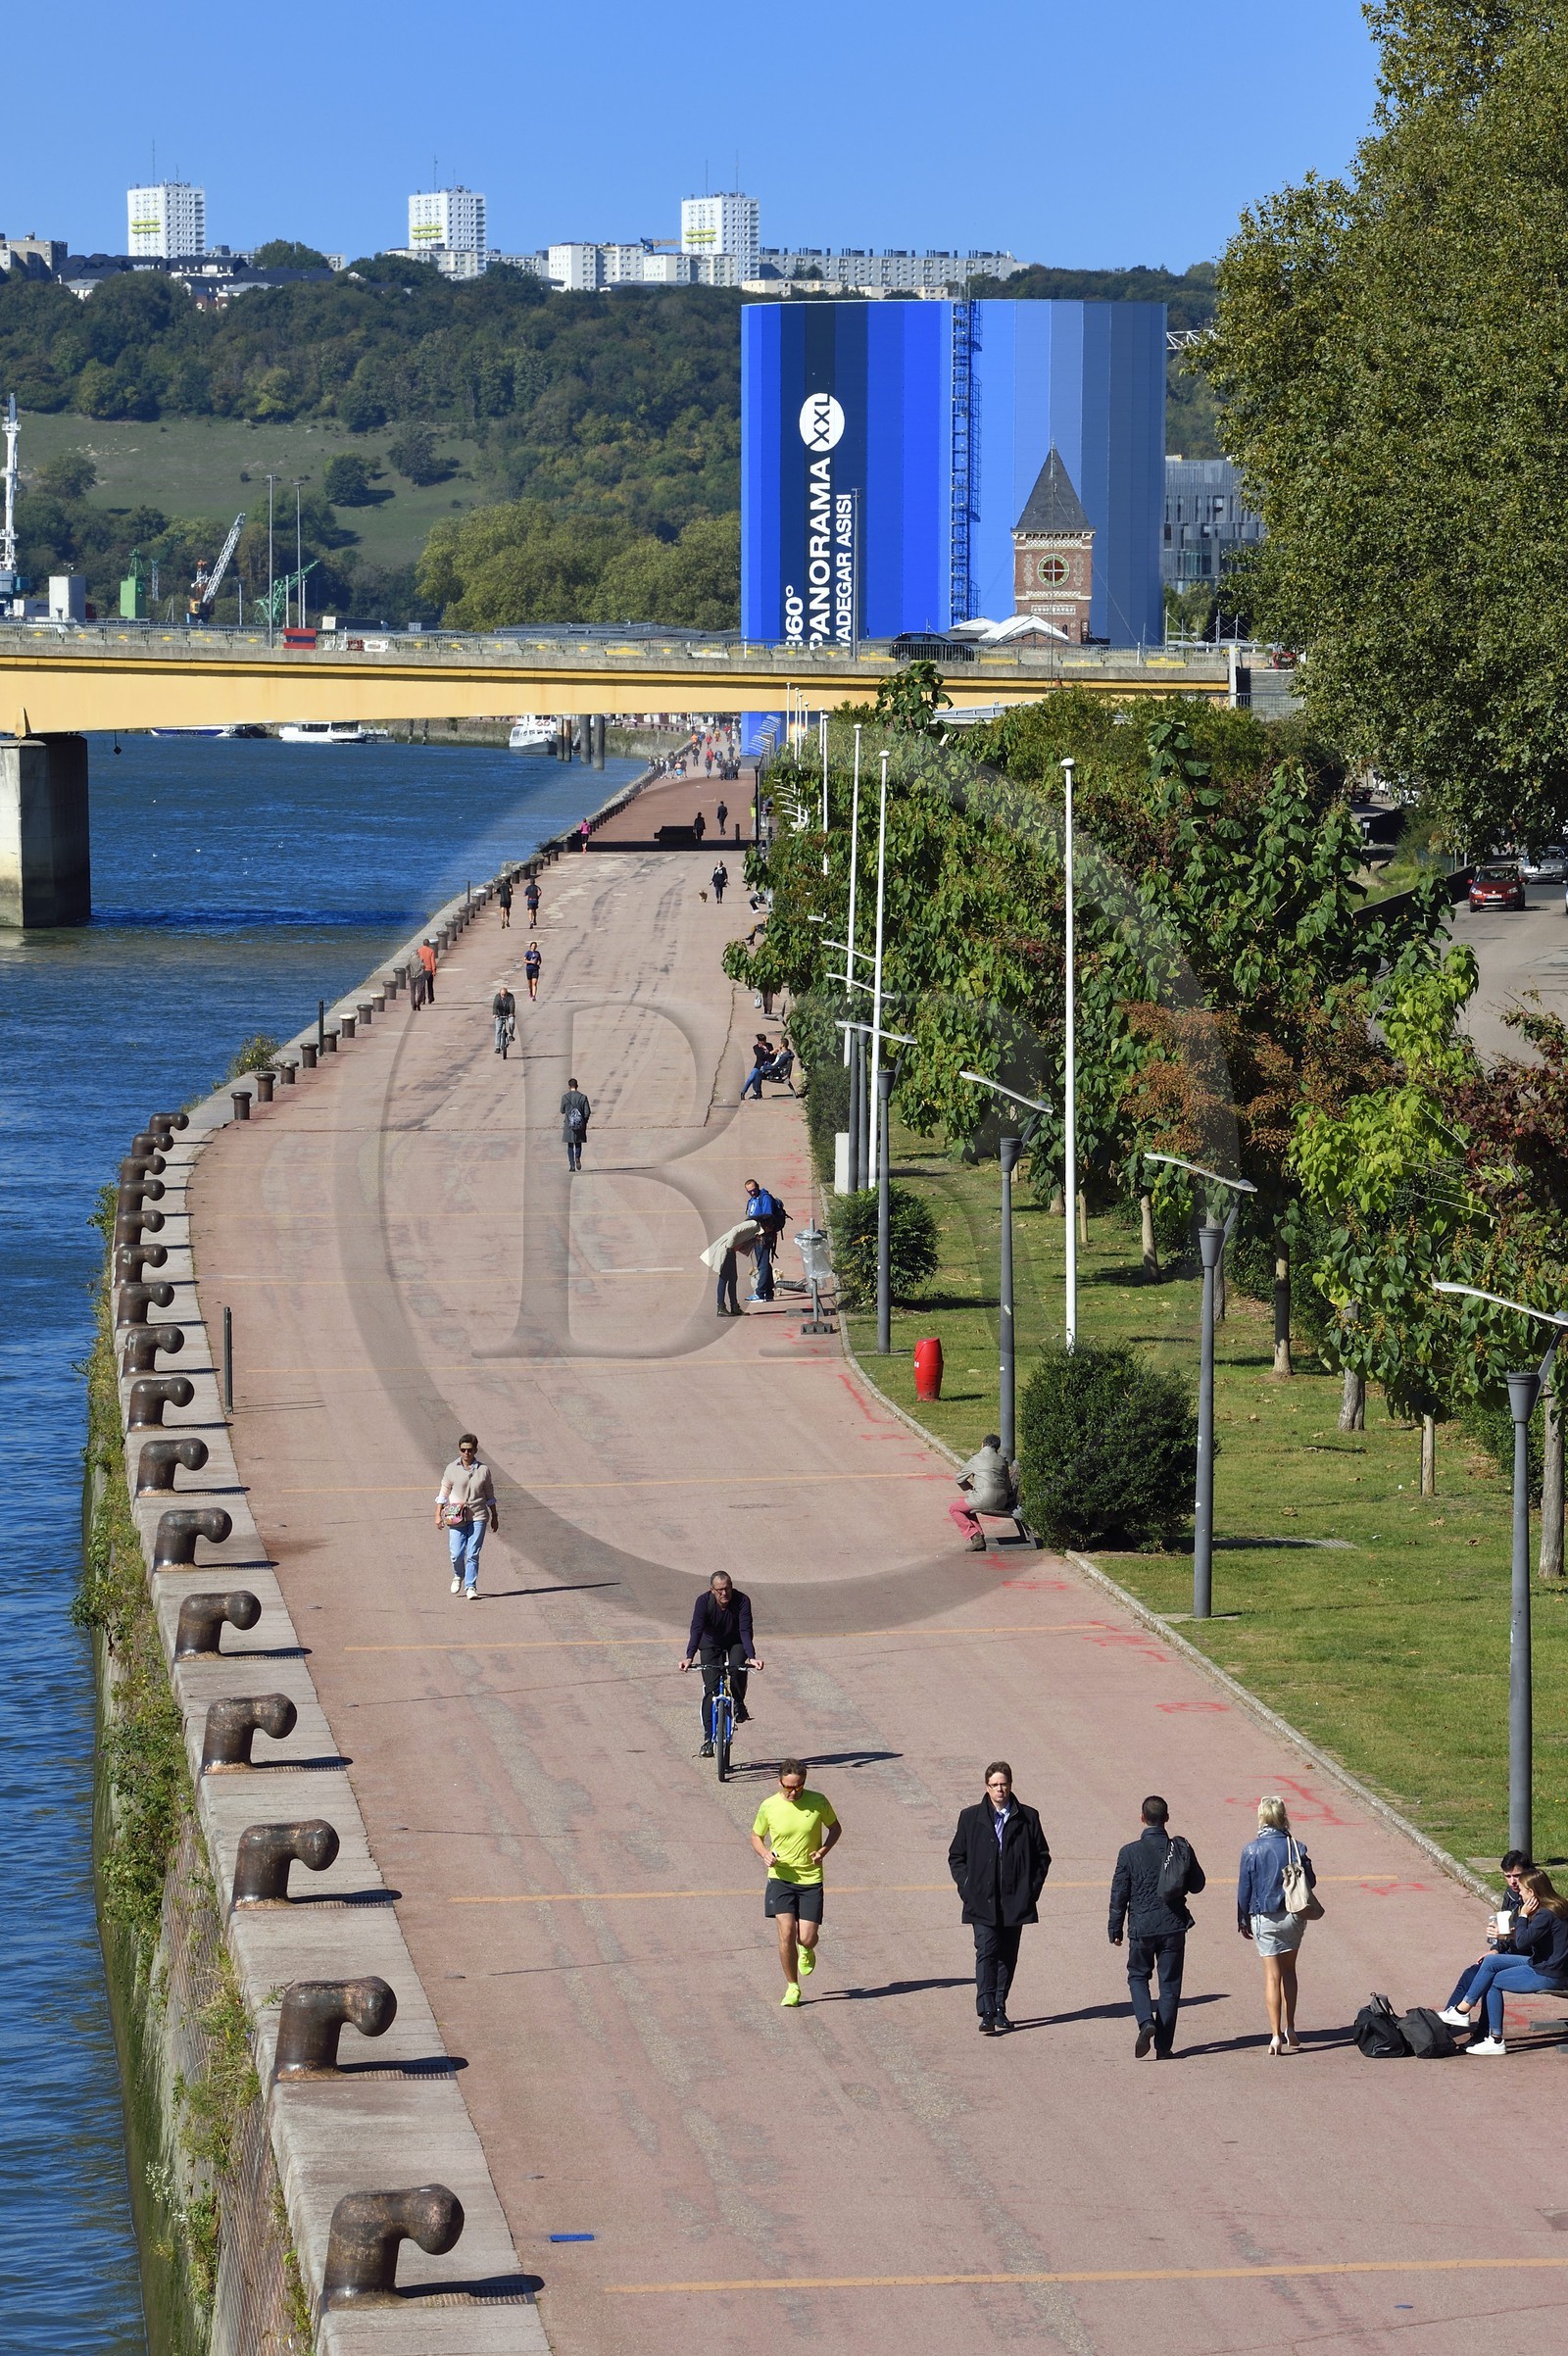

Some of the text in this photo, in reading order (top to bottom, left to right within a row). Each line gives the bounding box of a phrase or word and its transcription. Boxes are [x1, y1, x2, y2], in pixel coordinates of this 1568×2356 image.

[808, 393, 831, 651] PANORAMA XXL
[836, 494, 852, 547] ASISI
